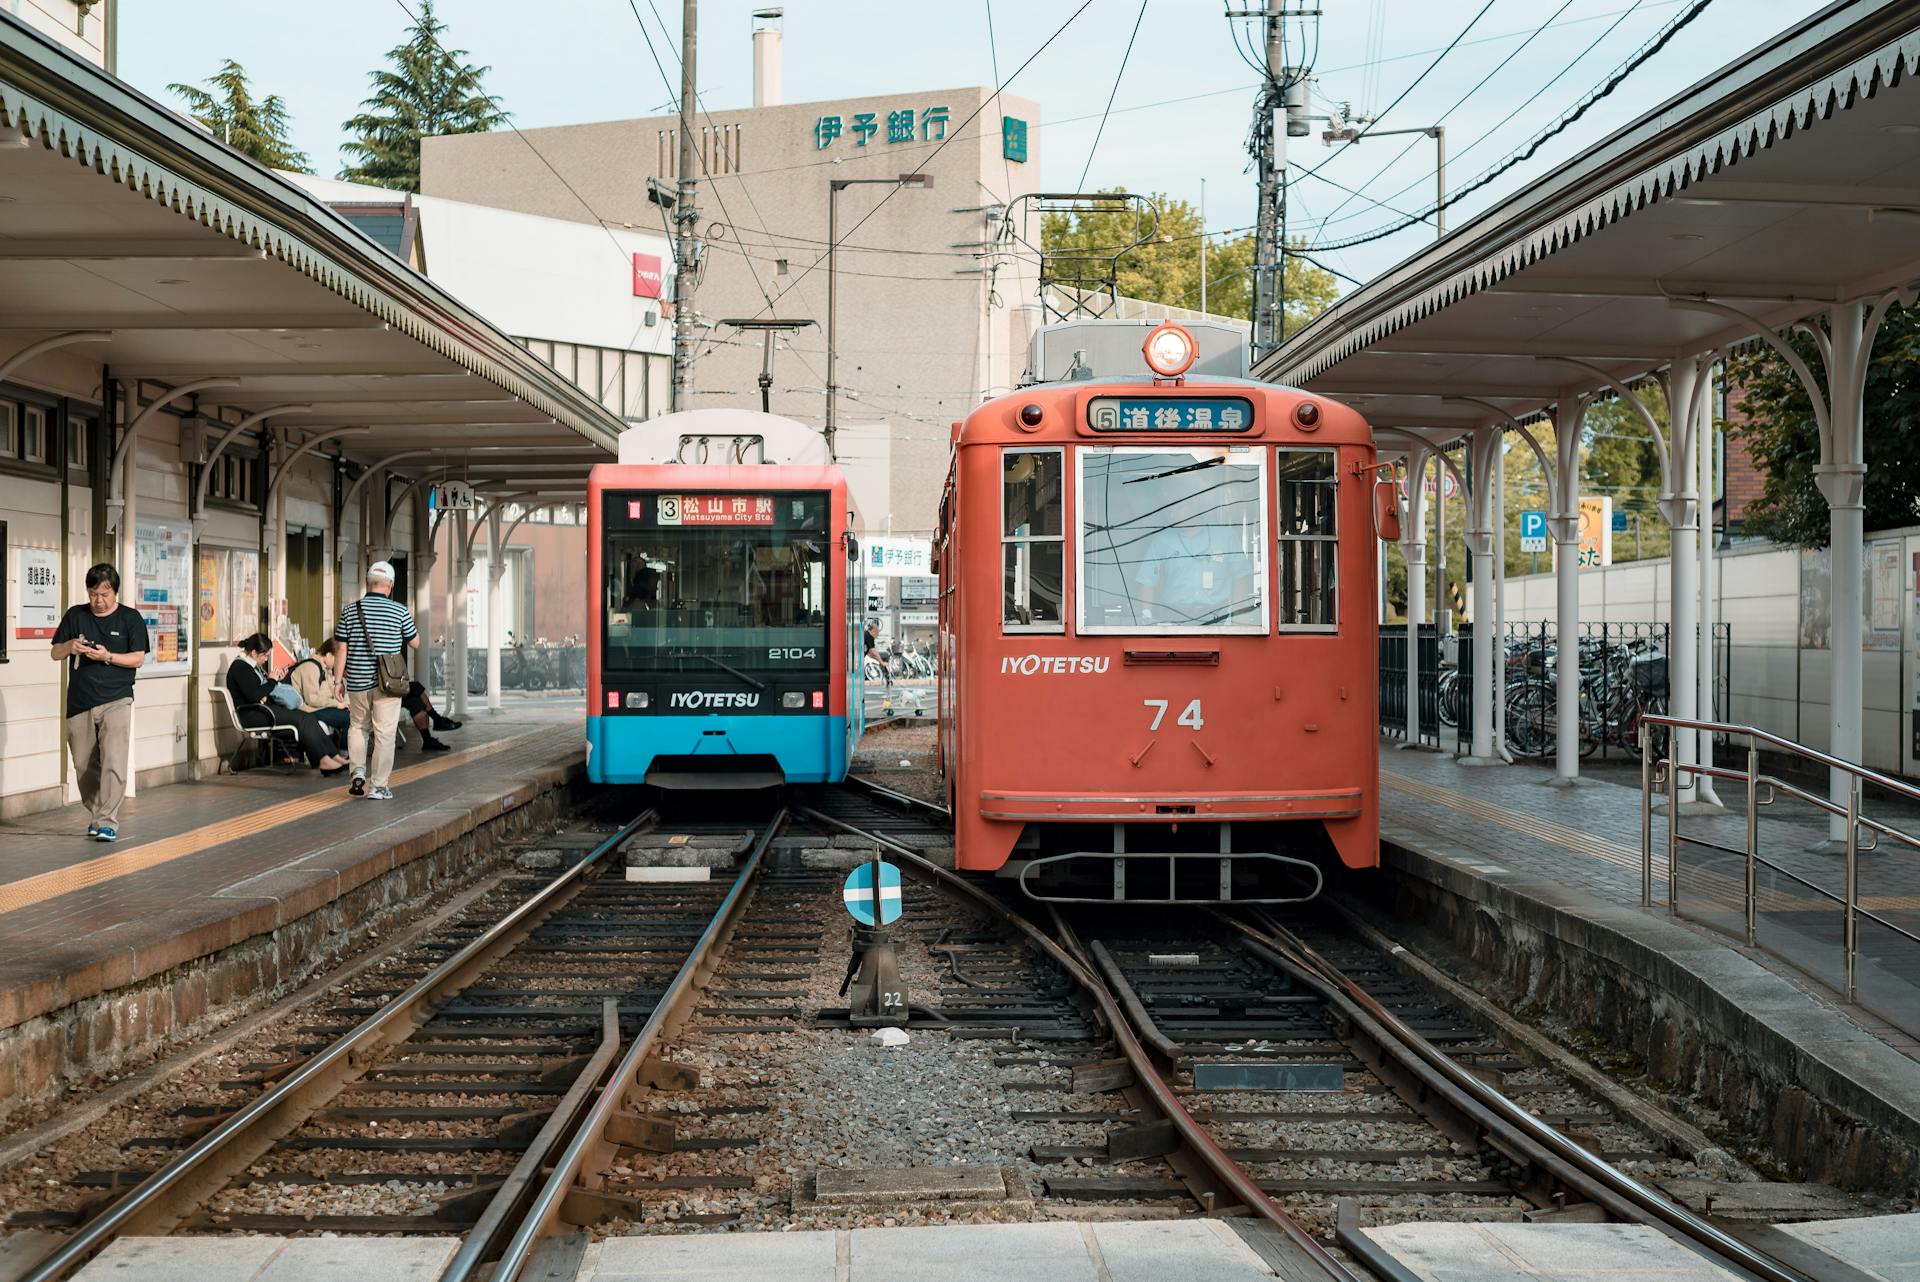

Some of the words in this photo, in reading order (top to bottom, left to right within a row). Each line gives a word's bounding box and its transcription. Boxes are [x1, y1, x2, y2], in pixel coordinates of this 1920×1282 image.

[815, 106, 951, 150] 伊予銀行
[1100, 411, 1113, 429] 5
[1122, 407, 1244, 430] 道後温泉
[664, 500, 677, 518] 3
[683, 498, 772, 514] 松山市駅
[683, 513, 732, 522] Matsuyama
[735, 513, 752, 522] City
[755, 513, 773, 521] Sta.
[1527, 514, 1542, 536] P
[886, 549, 922, 566] 伊予銀行
[768, 648, 816, 659] 2104
[1001, 654, 1110, 675] IYOTETSU
[670, 690, 760, 709] IYOTETSU
[1143, 699, 1204, 731] 74
[884, 991, 904, 1007] 22
